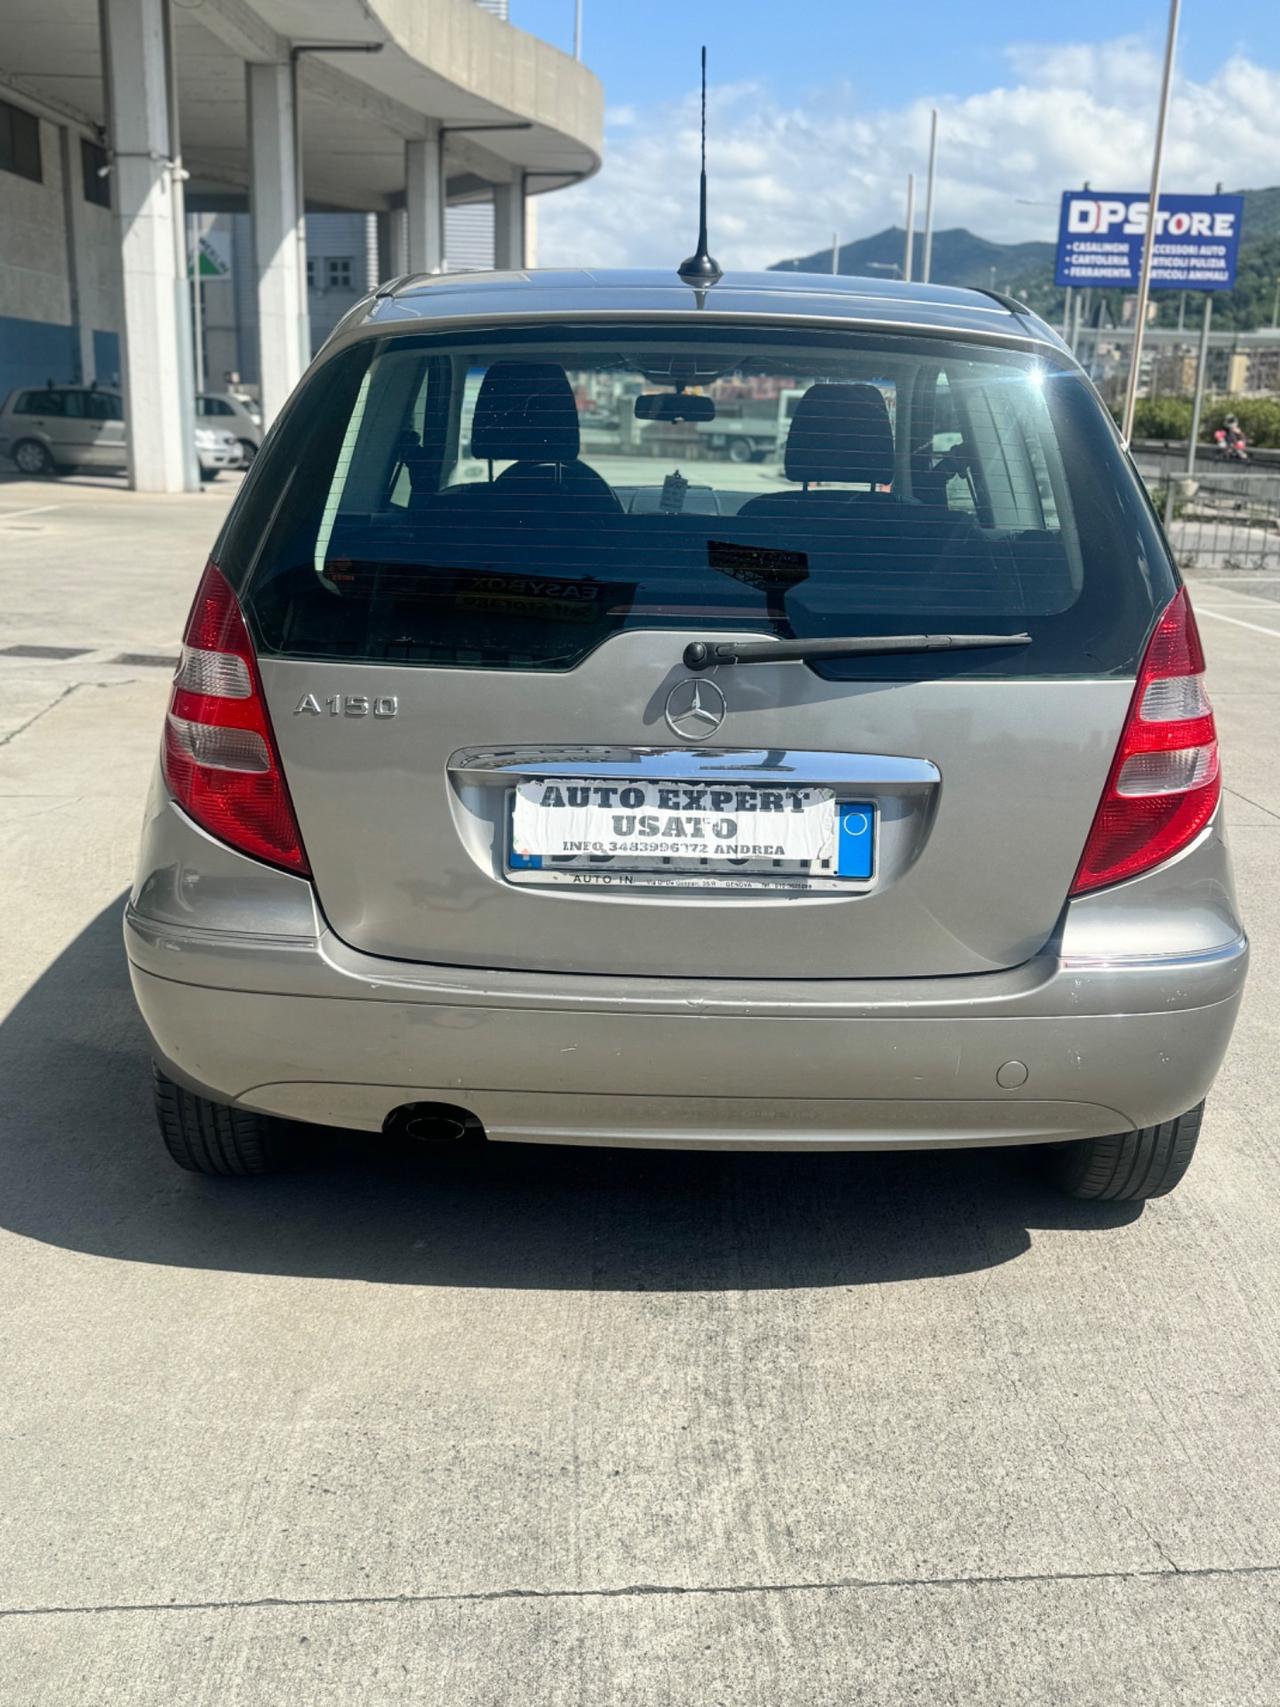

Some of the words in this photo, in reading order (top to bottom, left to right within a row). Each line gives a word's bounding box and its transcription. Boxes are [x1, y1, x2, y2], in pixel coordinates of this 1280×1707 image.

[1072, 242, 1130, 253] CASALINGHI
[1151, 244, 1198, 256] CCESSORI
[1200, 245, 1227, 256] AUTO
[1071, 255, 1129, 266] CARTOLERIA
[1190, 258, 1226, 269] PULIZIA
[1069, 267, 1132, 278] FERRAMENTA
[1188, 270, 1229, 281] ANIMALI
[295, 694, 399, 718] A150
[540, 786, 646, 809] AUTO
[657, 788, 810, 813] EXPERT
[611, 814, 738, 839] USATO
[713, 844, 785, 856] ANDREA
[573, 874, 613, 884] AUTO
[618, 875, 633, 885] IN
